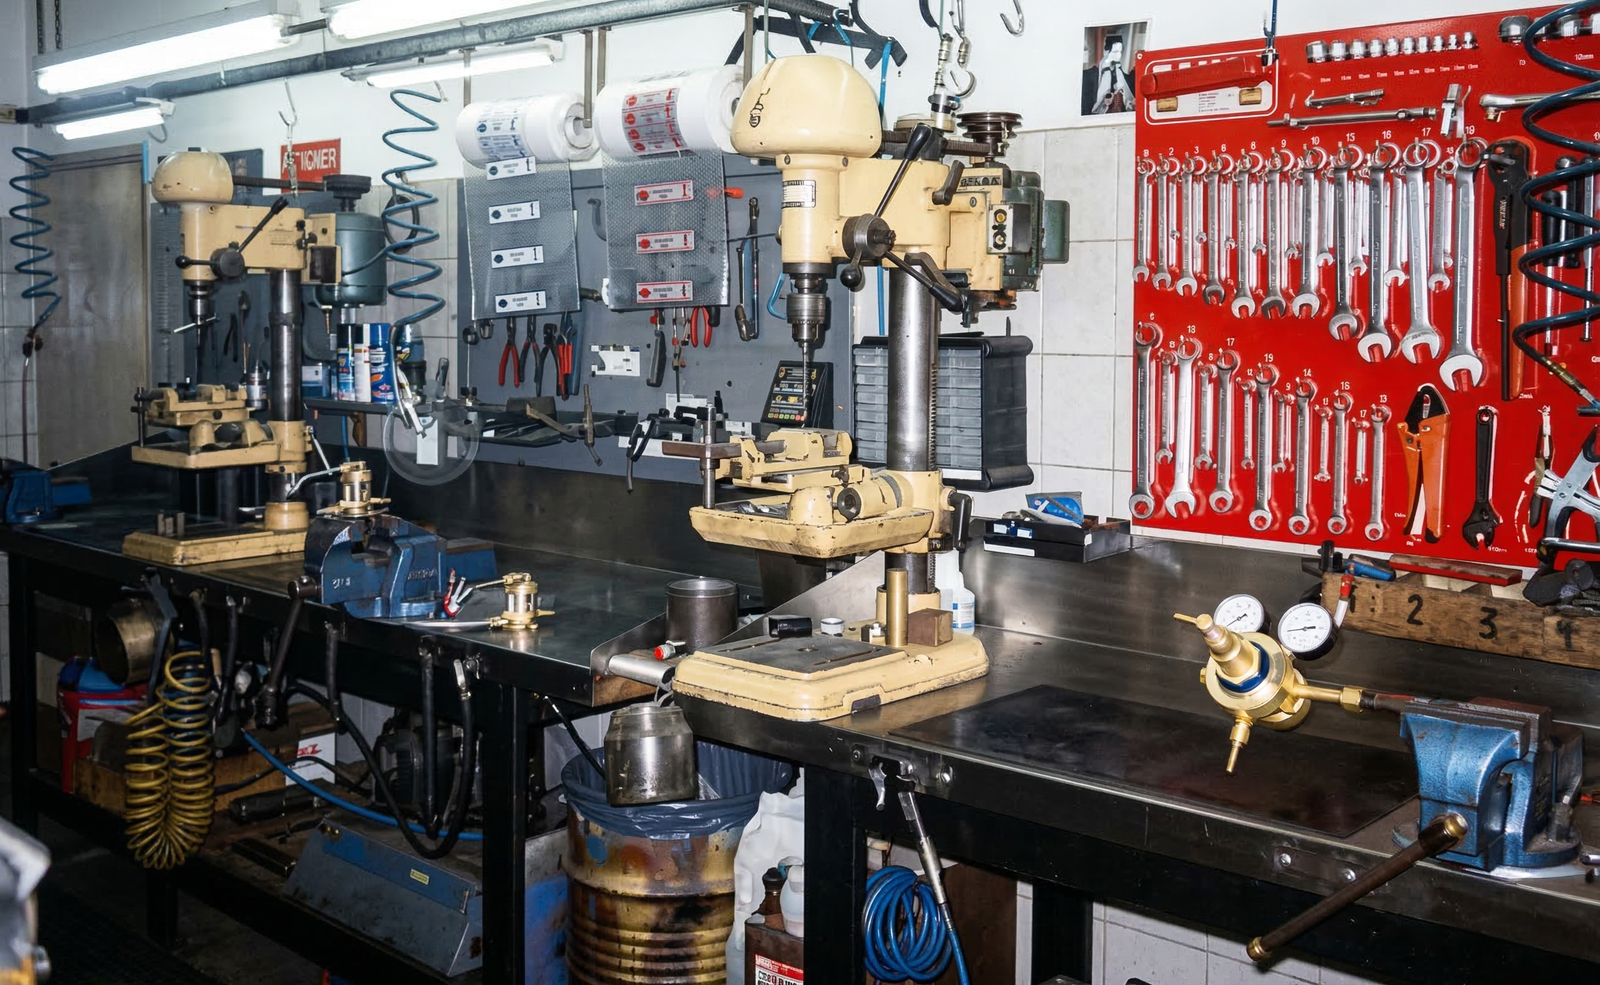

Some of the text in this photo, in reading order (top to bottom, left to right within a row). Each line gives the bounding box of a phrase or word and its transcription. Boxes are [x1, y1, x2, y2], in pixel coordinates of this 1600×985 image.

[1382, 130, 1391, 139] 16
[1422, 128, 1431, 136] 17
[1311, 136, 1320, 145] 10
[1346, 133, 1355, 141] 15
[1221, 143, 1226, 152] 6
[1251, 141, 1256, 150] 8
[1281, 139, 1286, 148] 9
[1169, 147, 1174, 156] 2
[1194, 146, 1199, 154] 3
[1226, 338, 1235, 346] 17
[1264, 353, 1274, 362] 19
[1303, 369, 1311, 377] 14
[1340, 381, 1350, 390] 16
[1380, 395, 1387, 403] 13
[1360, 410, 1367, 418] 17
[1407, 594, 1424, 625] 2
[1479, 606, 1498, 639] 3
